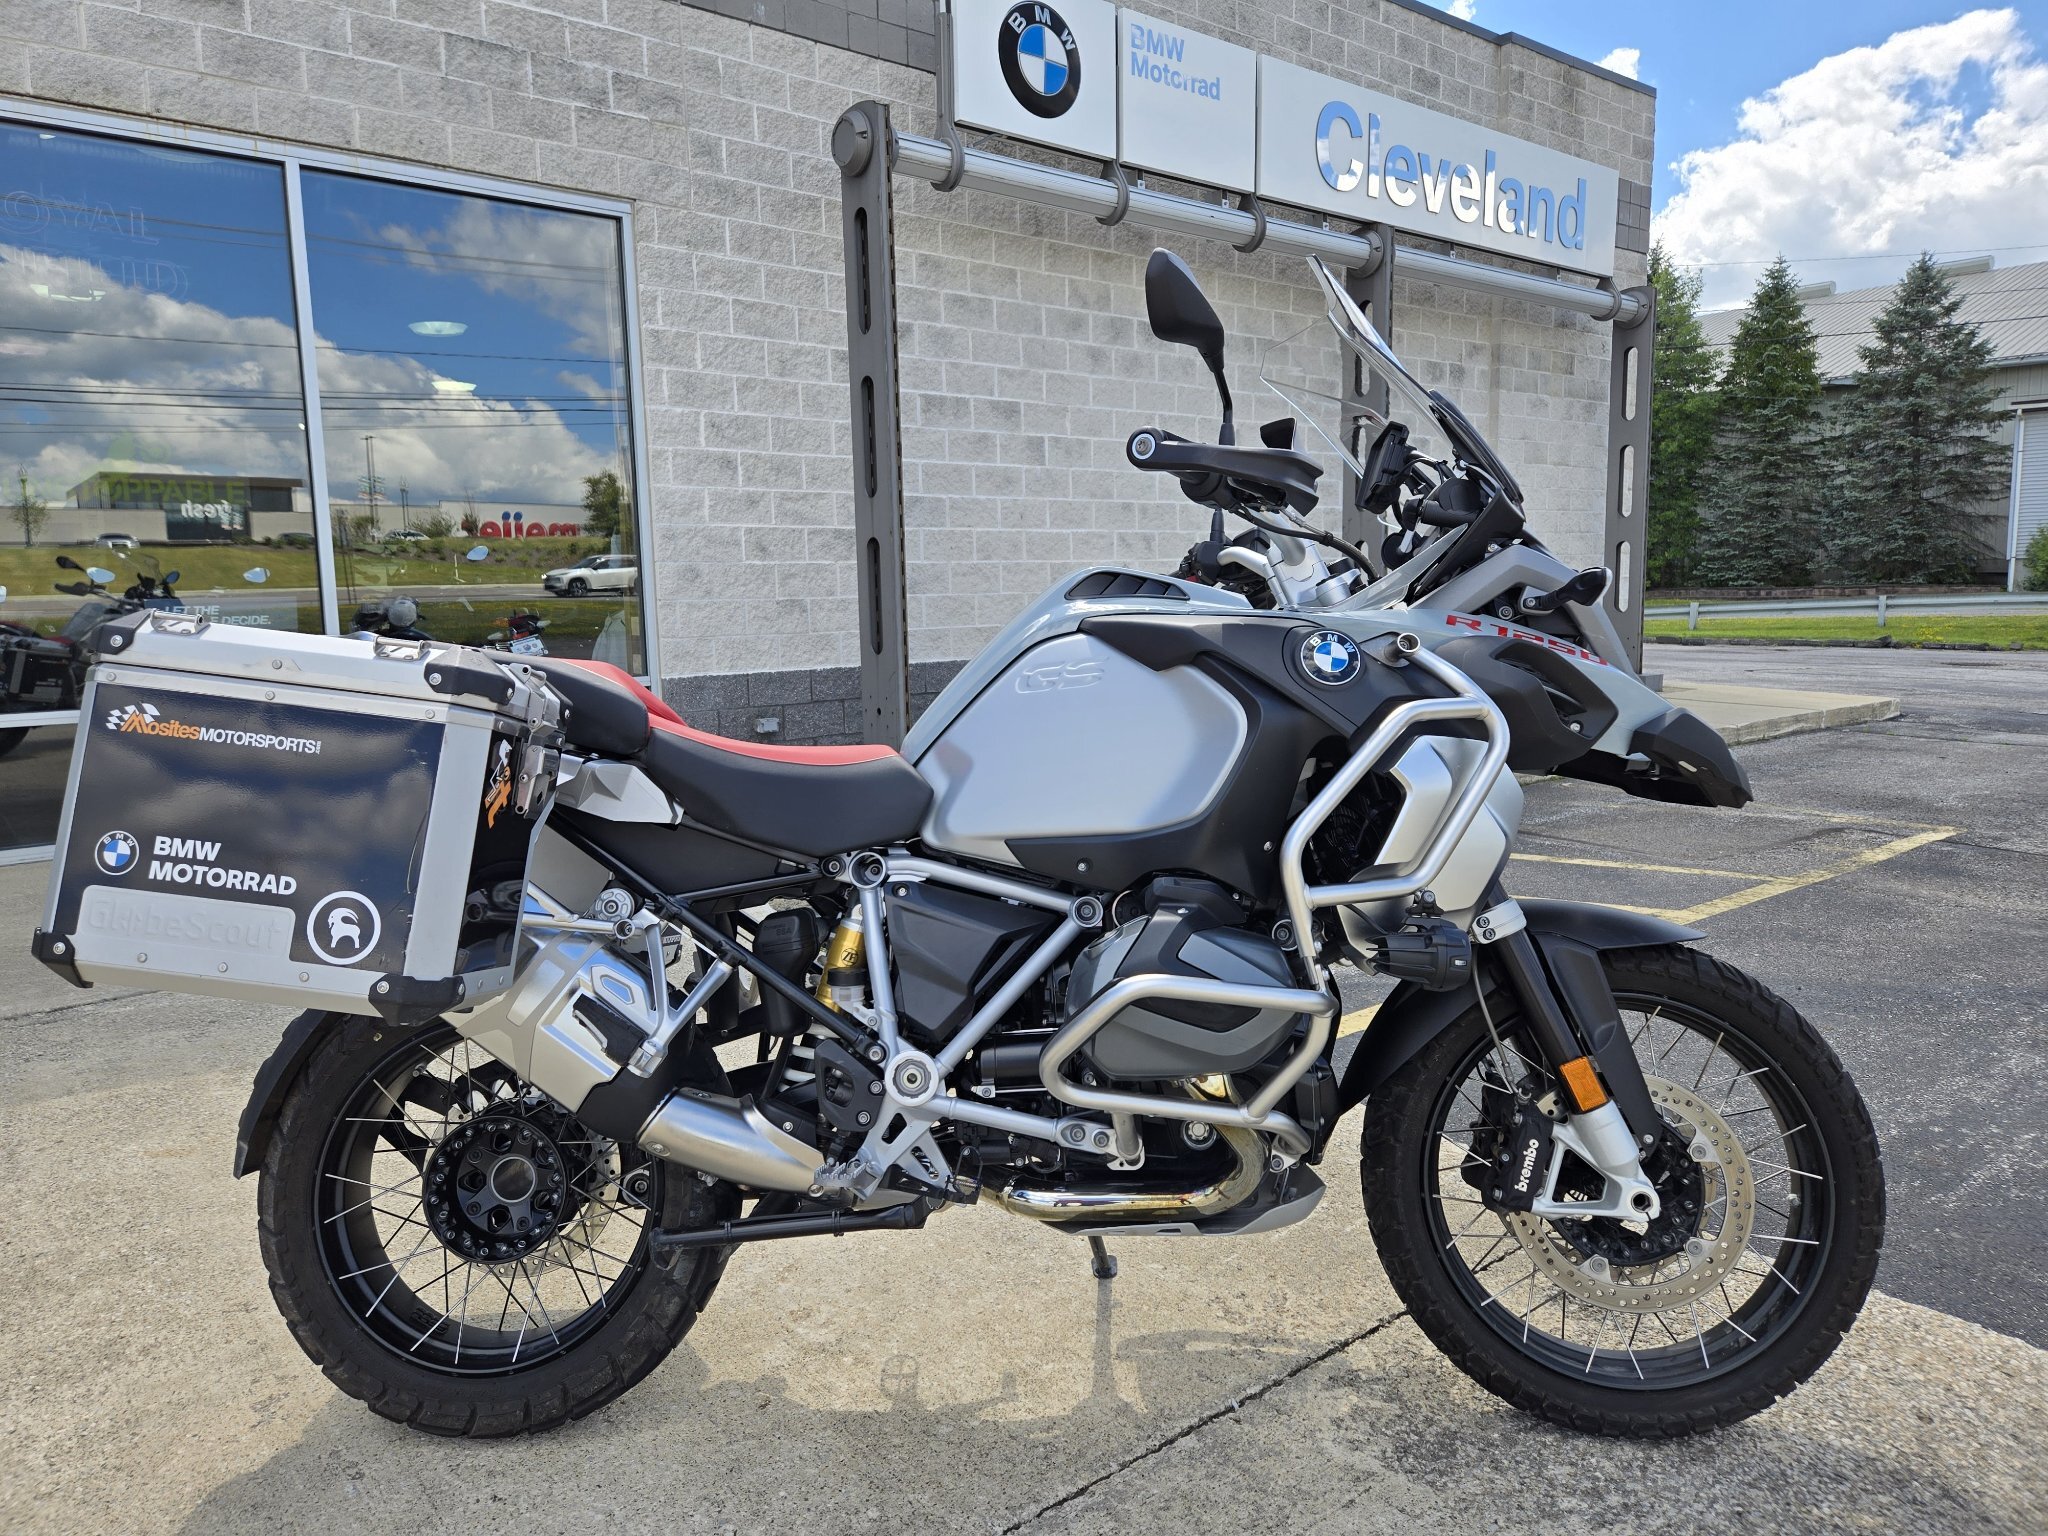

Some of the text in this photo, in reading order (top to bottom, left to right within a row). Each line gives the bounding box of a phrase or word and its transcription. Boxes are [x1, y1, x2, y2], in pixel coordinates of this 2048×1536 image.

[1130, 23, 1185, 62] BMW
[1130, 51, 1222, 101] Motorrad
[1315, 100, 1587, 250] Cleveland
[195, 606, 220, 615] THE
[153, 835, 222, 862] BMW
[148, 860, 297, 896] MOTORRAD
[1514, 1138, 1539, 1192] brembo
